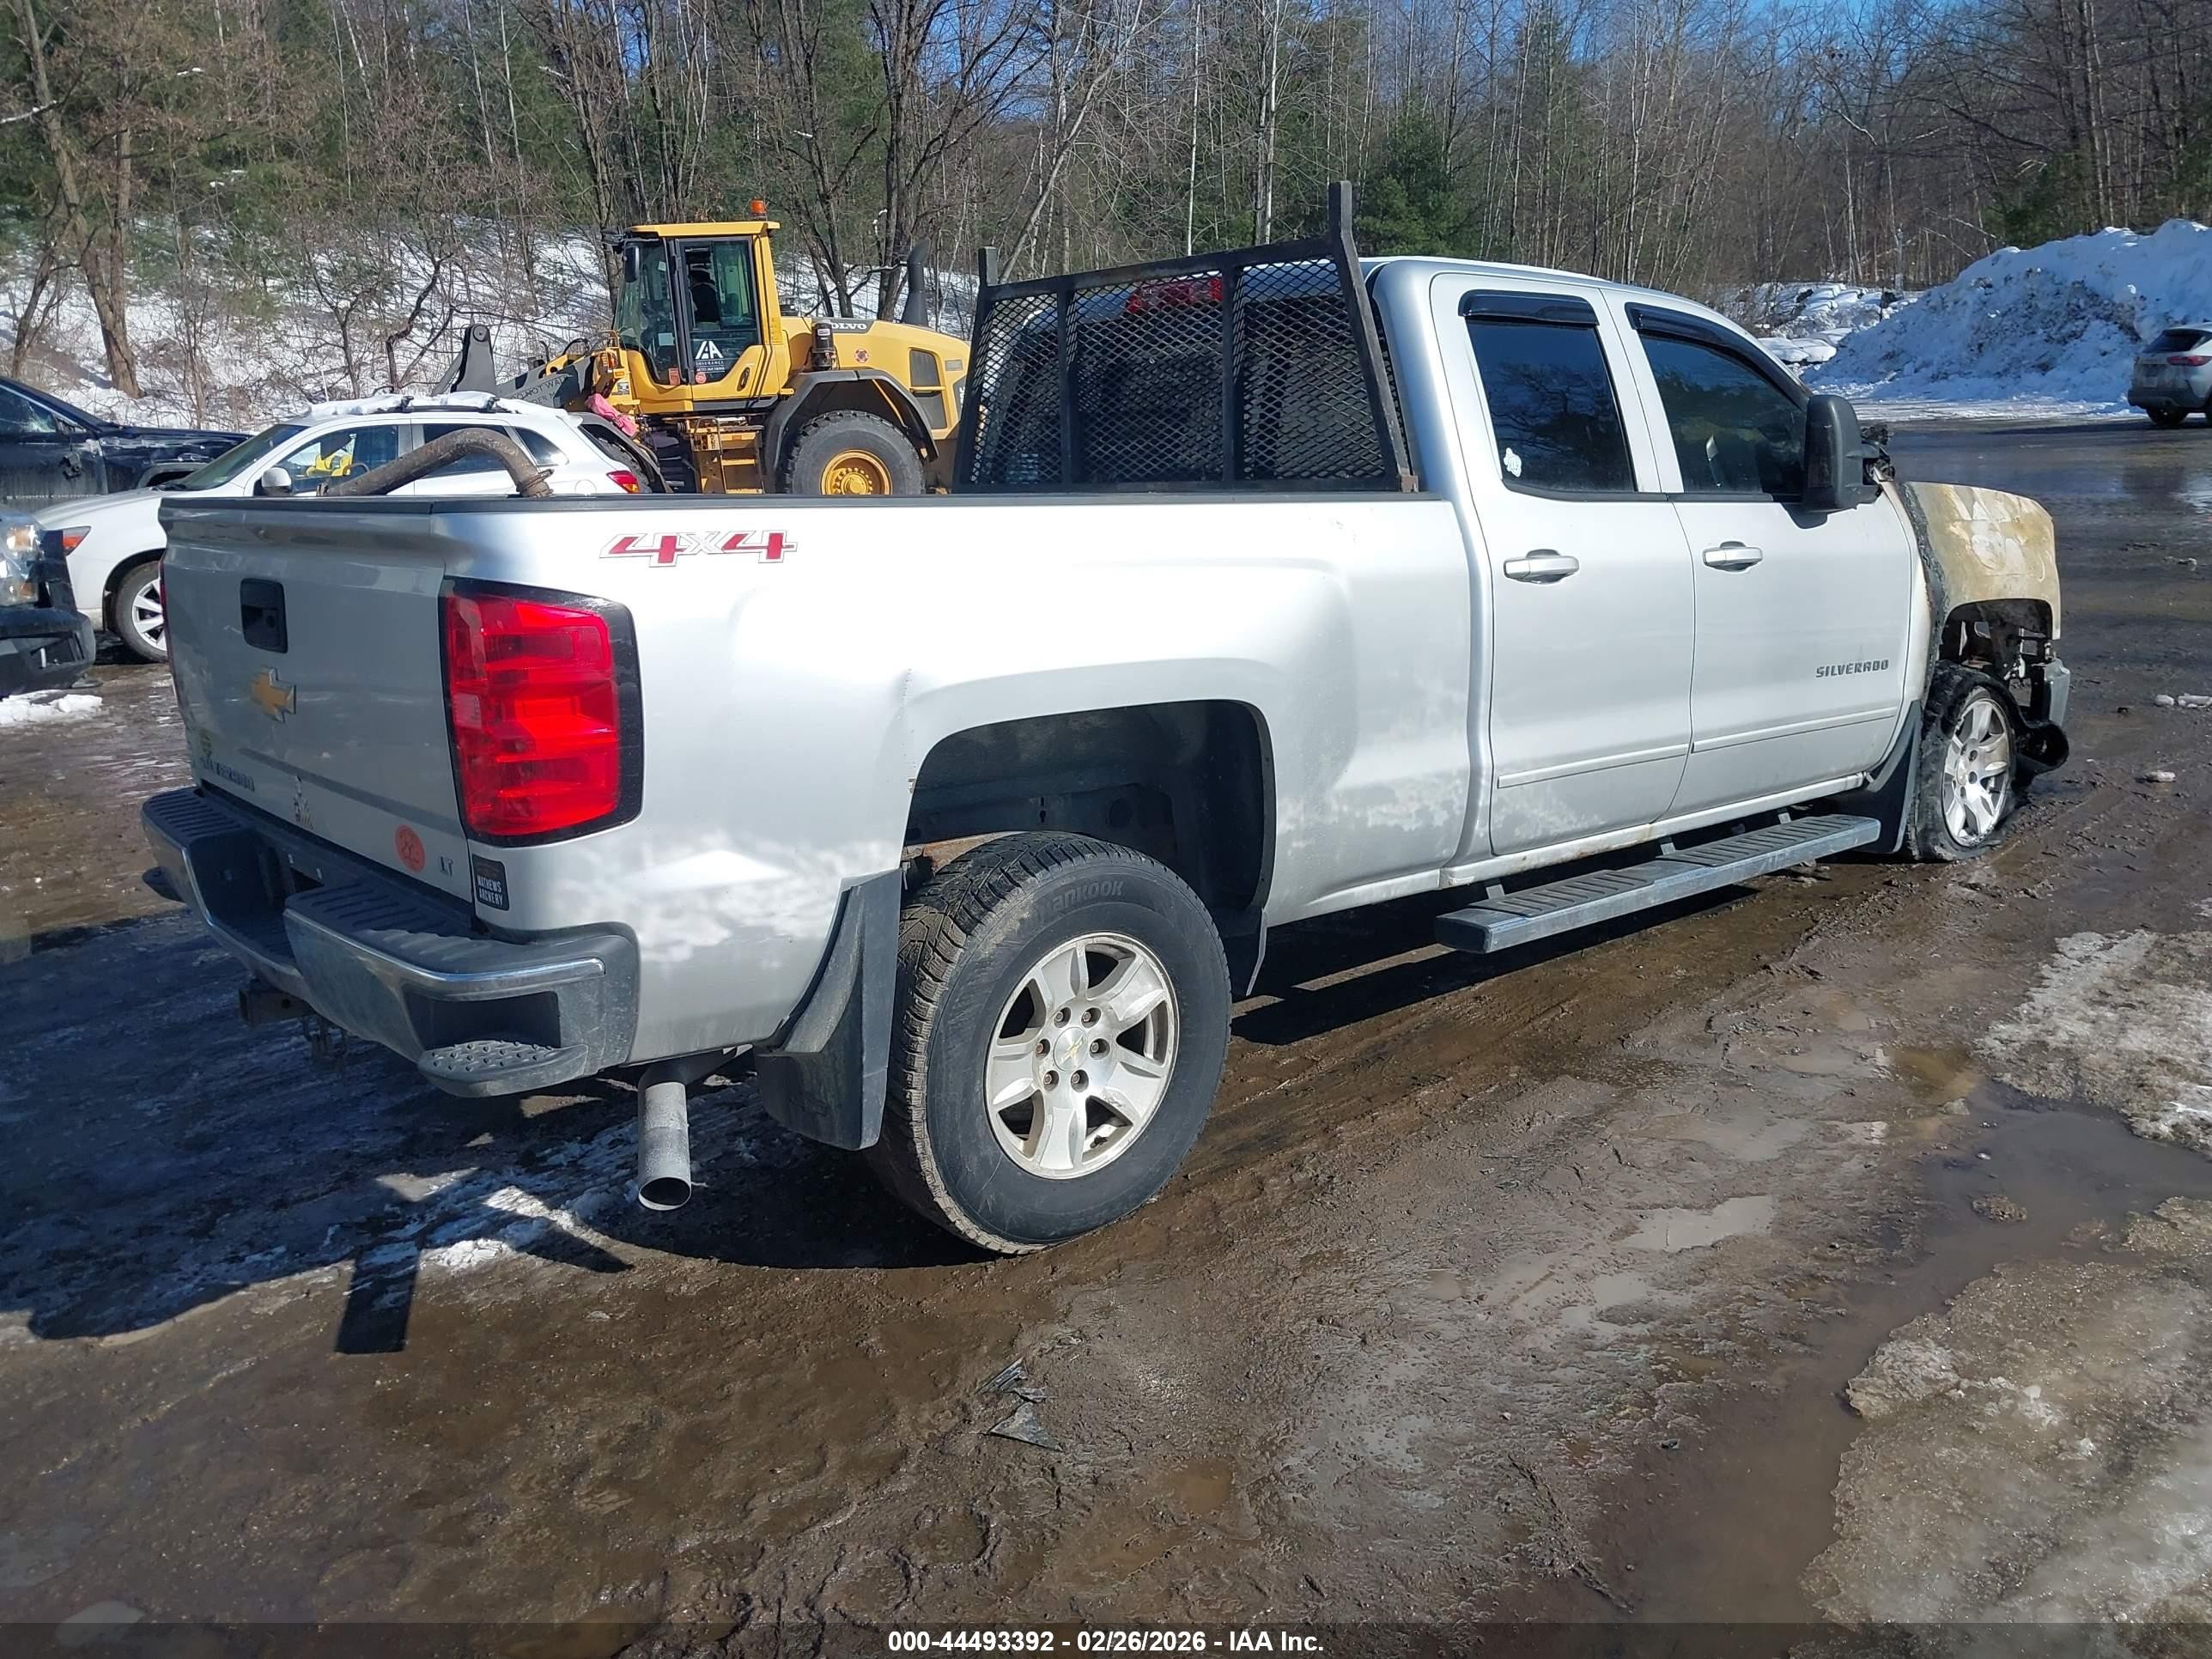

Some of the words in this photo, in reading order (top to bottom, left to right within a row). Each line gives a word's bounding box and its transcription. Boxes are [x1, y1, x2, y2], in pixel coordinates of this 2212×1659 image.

[1814, 659, 1889, 678] SILVERADO
[440, 856, 453, 877] LT
[477, 874, 502, 893] MATHEWS
[478, 887, 503, 907] ARCHERY
